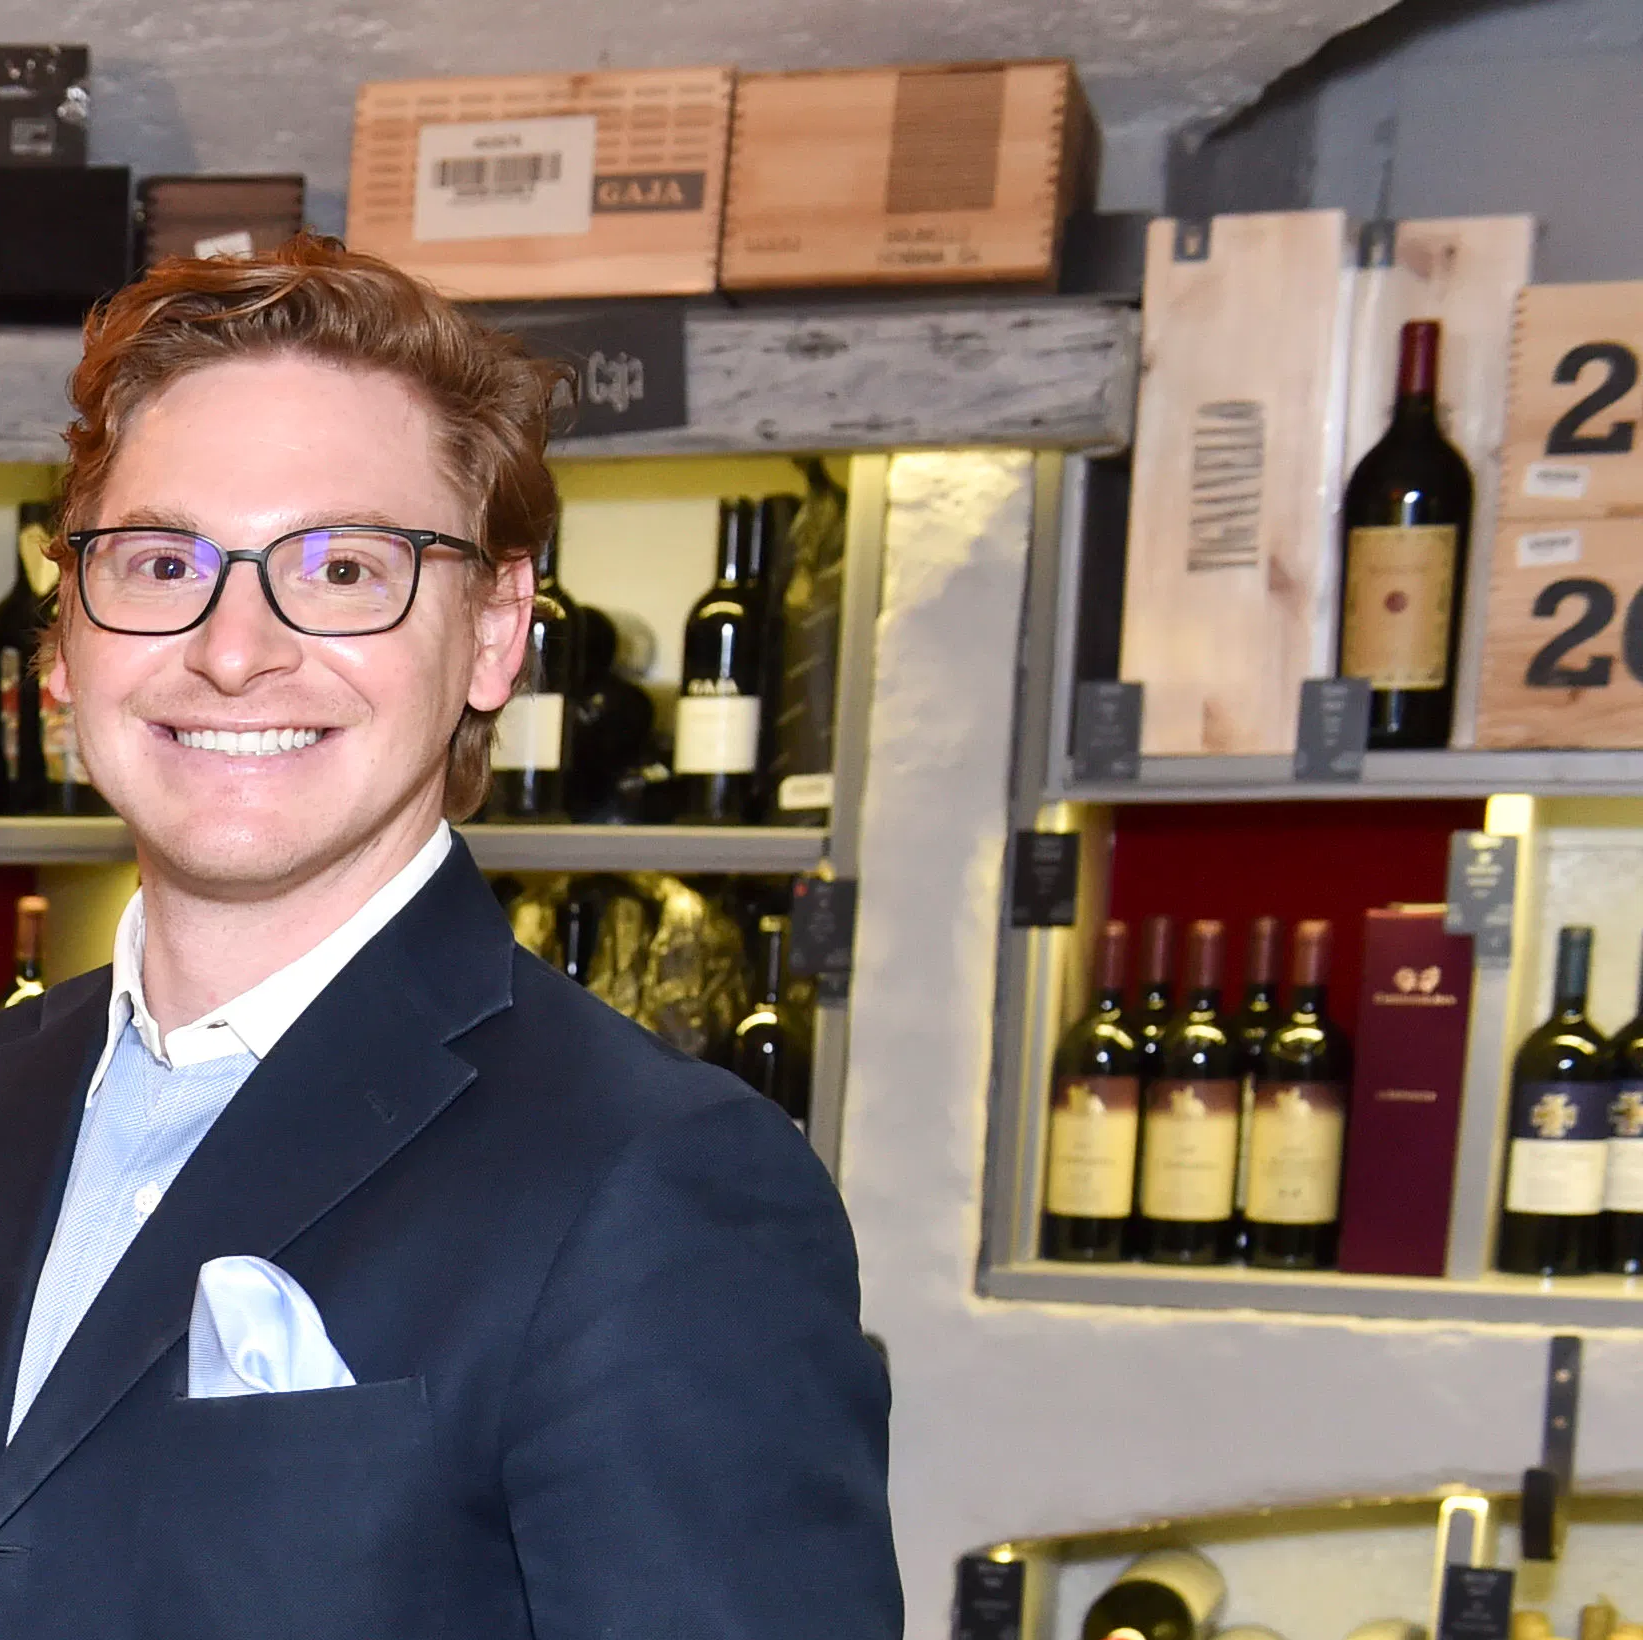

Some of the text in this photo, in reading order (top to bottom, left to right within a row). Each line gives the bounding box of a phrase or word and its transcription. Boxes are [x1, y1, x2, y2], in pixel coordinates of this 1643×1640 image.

[596, 176, 684, 206] GAJA
[1545, 342, 1643, 457] 2
[1525, 577, 1643, 690] 2
